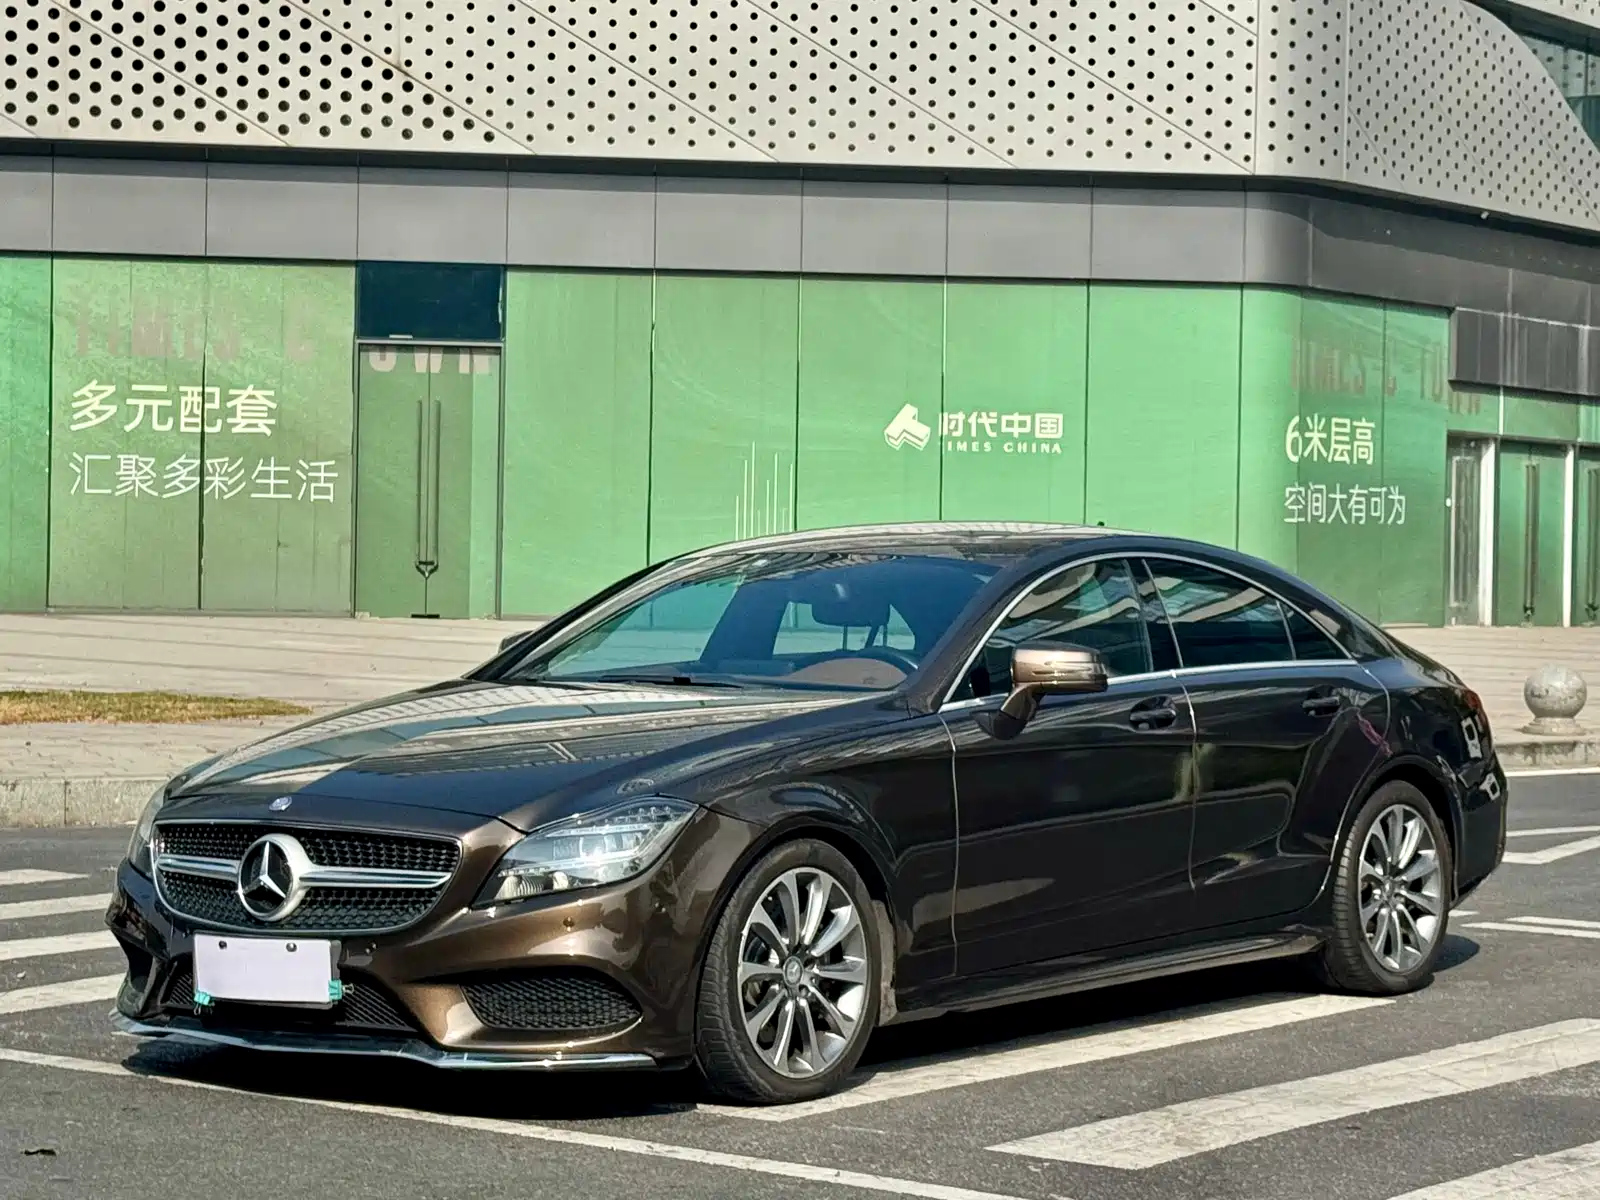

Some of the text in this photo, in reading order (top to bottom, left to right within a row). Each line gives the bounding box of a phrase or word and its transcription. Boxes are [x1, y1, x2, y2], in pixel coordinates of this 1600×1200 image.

[69, 378, 278, 437] 多元配套
[938, 411, 1064, 439] 时代中国
[939, 440, 1062, 454] IMES CHINA
[1285, 412, 1376, 465] 6米层高
[68, 451, 339, 503] 汇聚多彩生活
[1283, 481, 1406, 525] 空间大有可为
